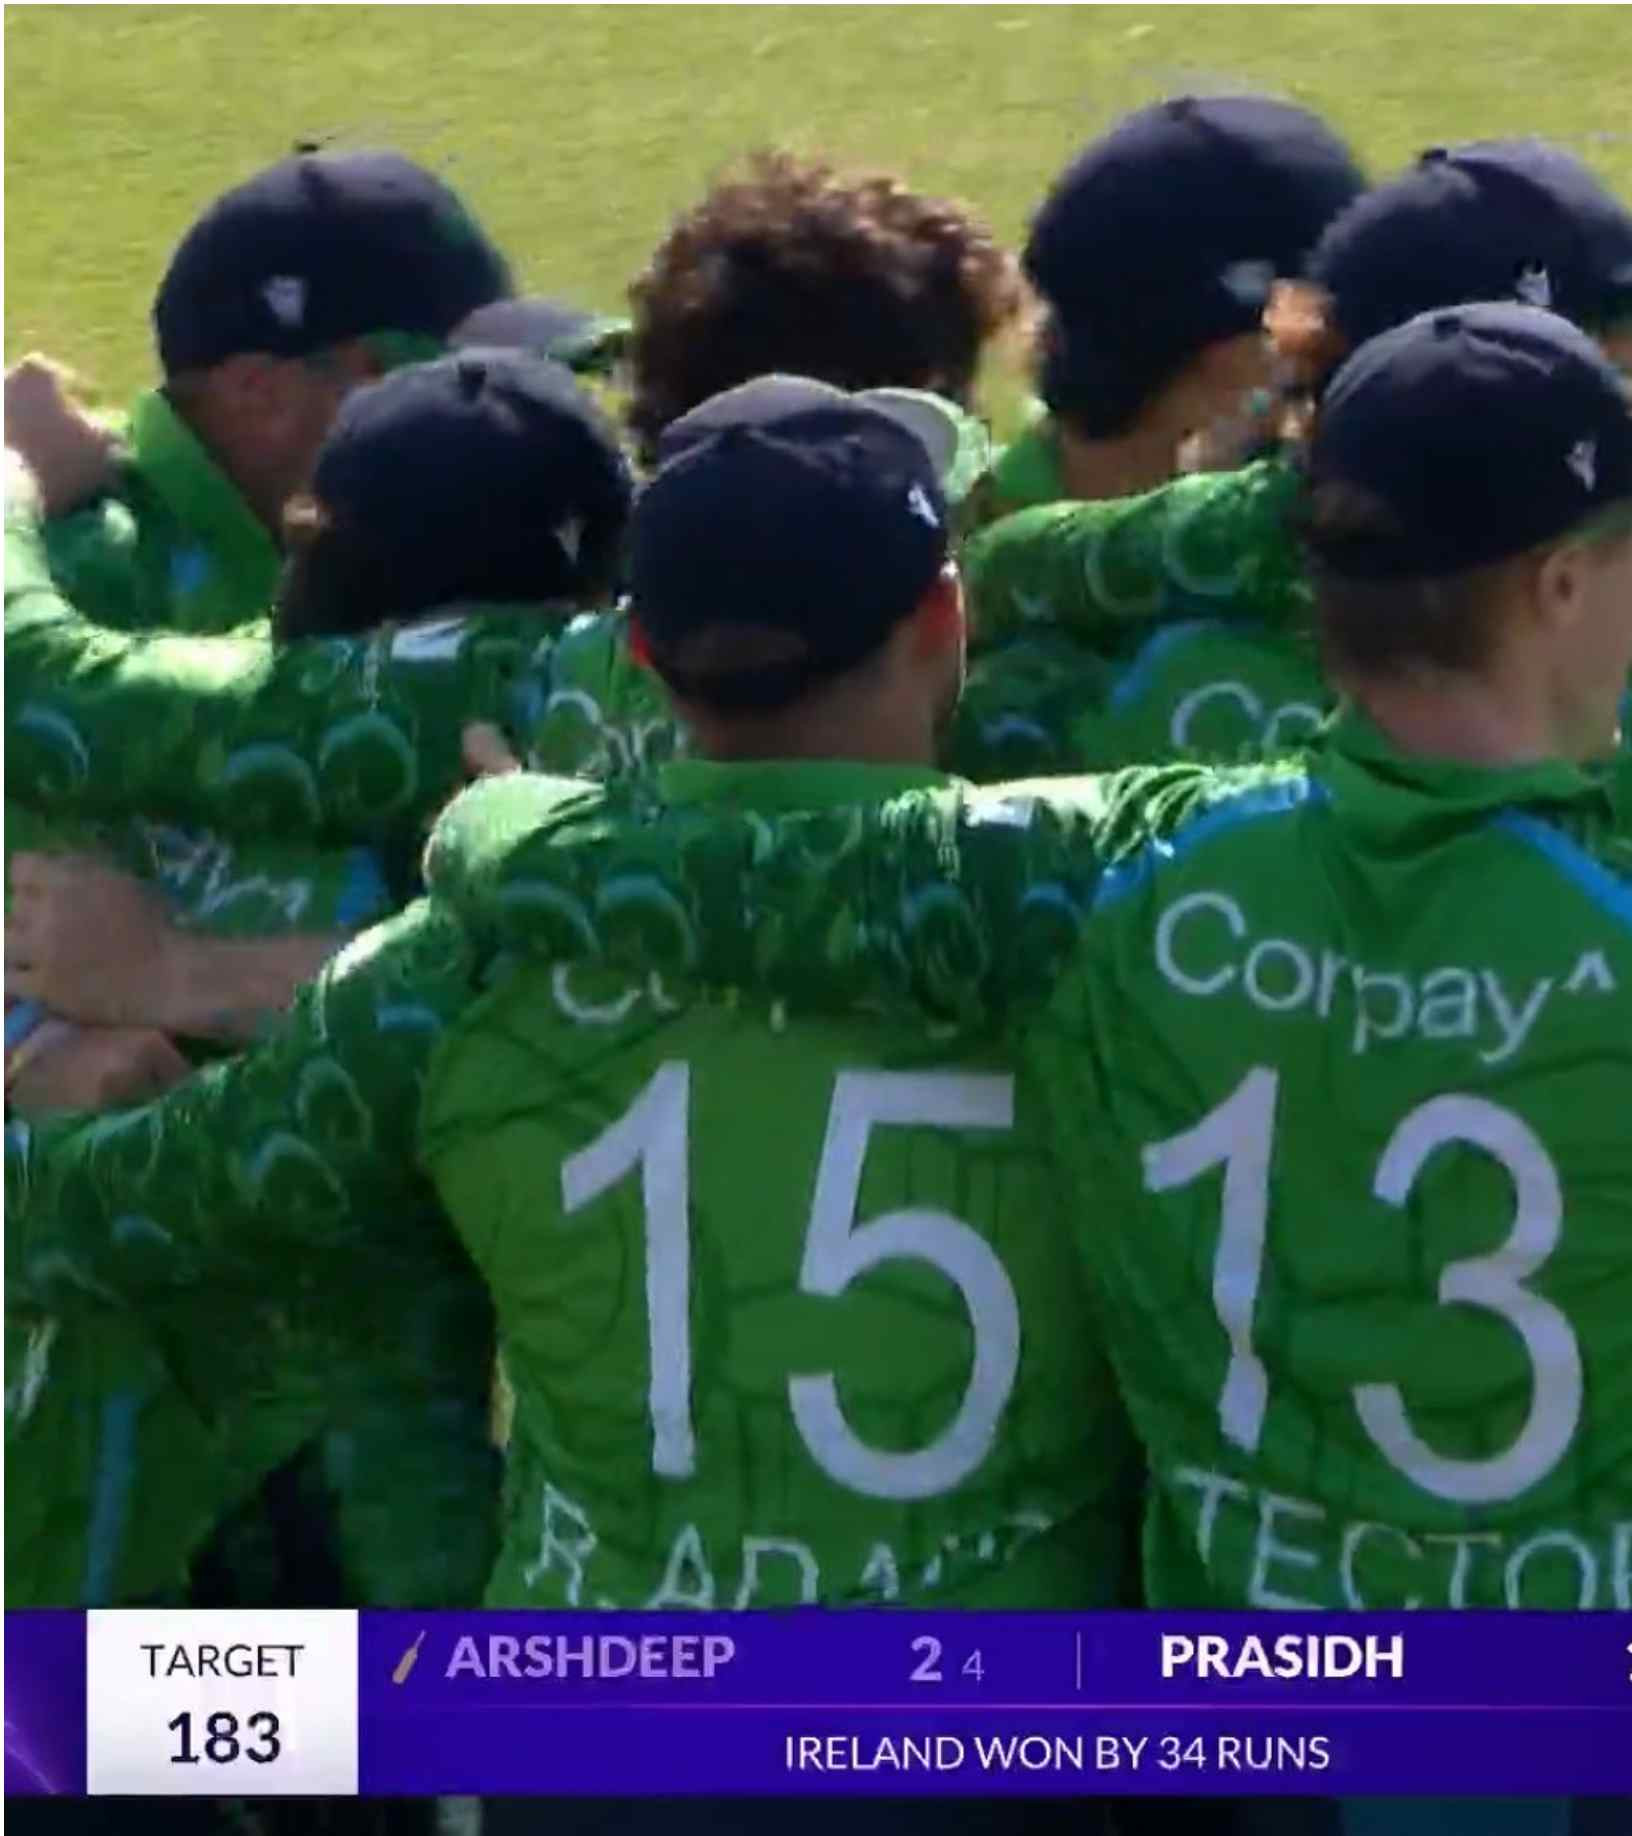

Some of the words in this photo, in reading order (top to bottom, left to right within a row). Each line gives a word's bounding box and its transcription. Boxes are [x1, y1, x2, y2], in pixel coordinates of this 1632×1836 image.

[1155, 891, 1552, 1065] Corpay
[561, 1061, 1020, 1500] 15
[1143, 1065, 1583, 1501] 13
